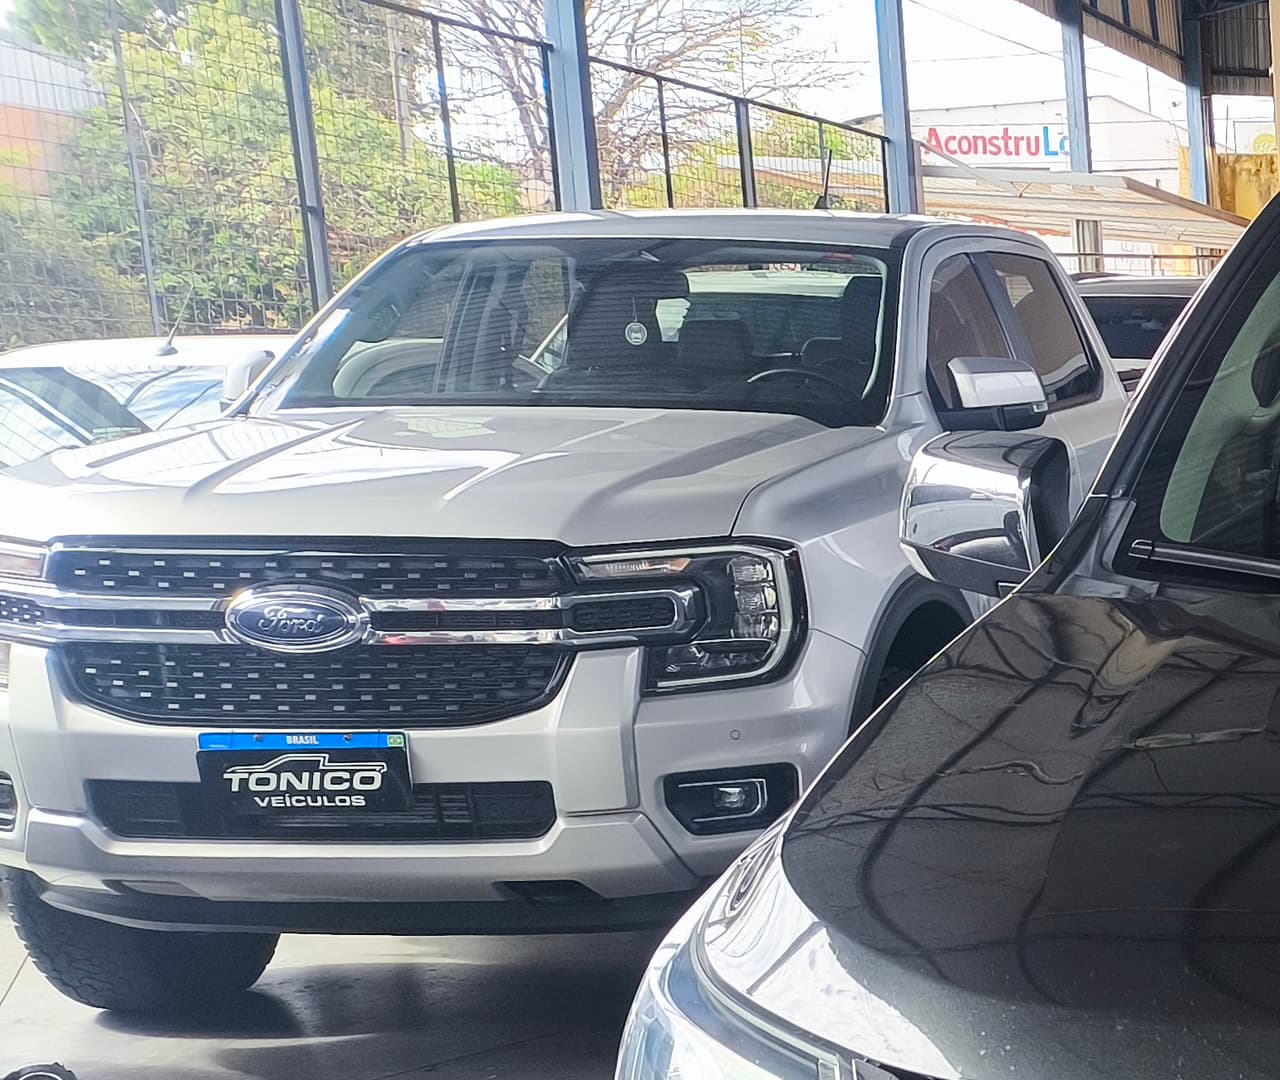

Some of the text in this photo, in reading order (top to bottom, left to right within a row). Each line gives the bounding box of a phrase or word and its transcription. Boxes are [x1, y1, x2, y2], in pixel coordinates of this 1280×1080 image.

[258, 606, 325, 633] Ford
[286, 735, 319, 745] BRASIL
[223, 772, 384, 792] TONICO
[253, 793, 367, 807] VEÍCULOS
